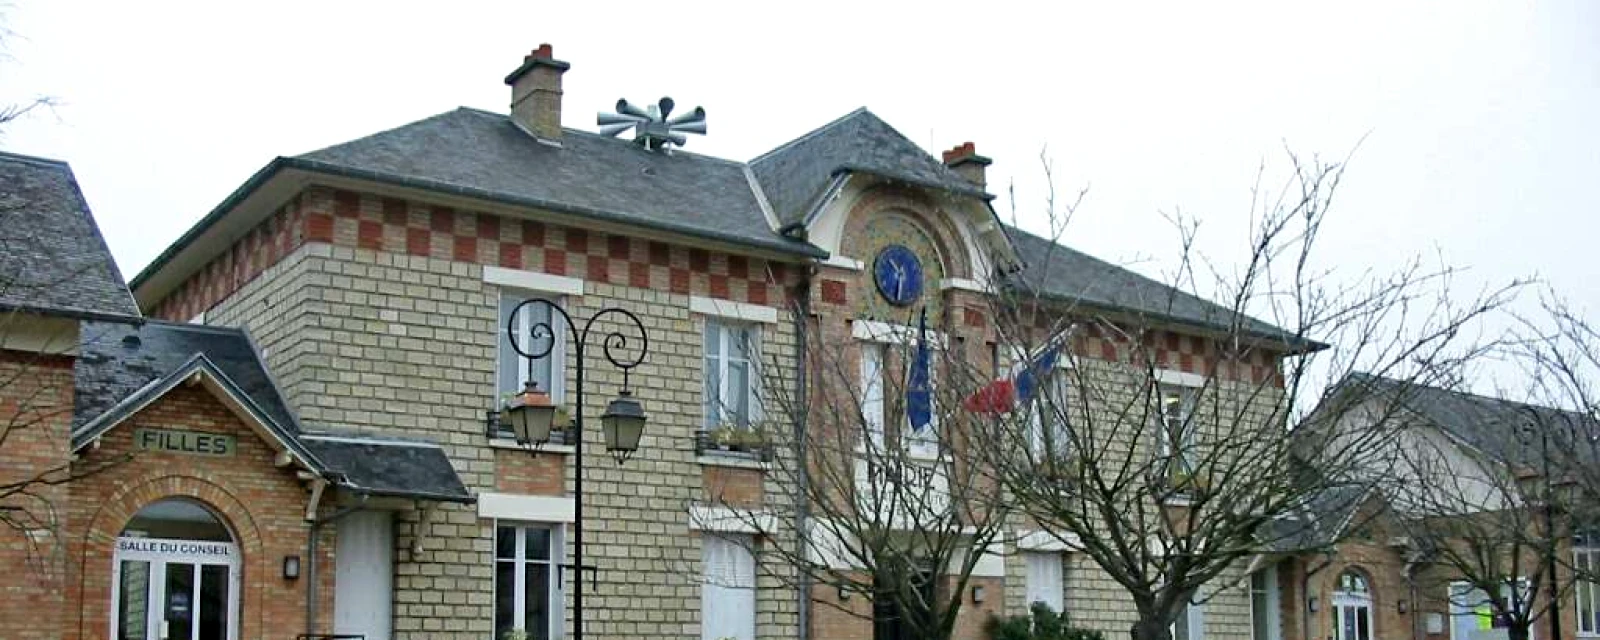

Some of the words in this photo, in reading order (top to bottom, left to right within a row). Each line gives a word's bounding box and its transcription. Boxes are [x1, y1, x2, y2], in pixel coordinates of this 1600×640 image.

[142, 430, 226, 454] FILLES
[120, 541, 157, 552] SALLE
[160, 543, 178, 553] DU
[180, 544, 228, 555] CONSEIL
